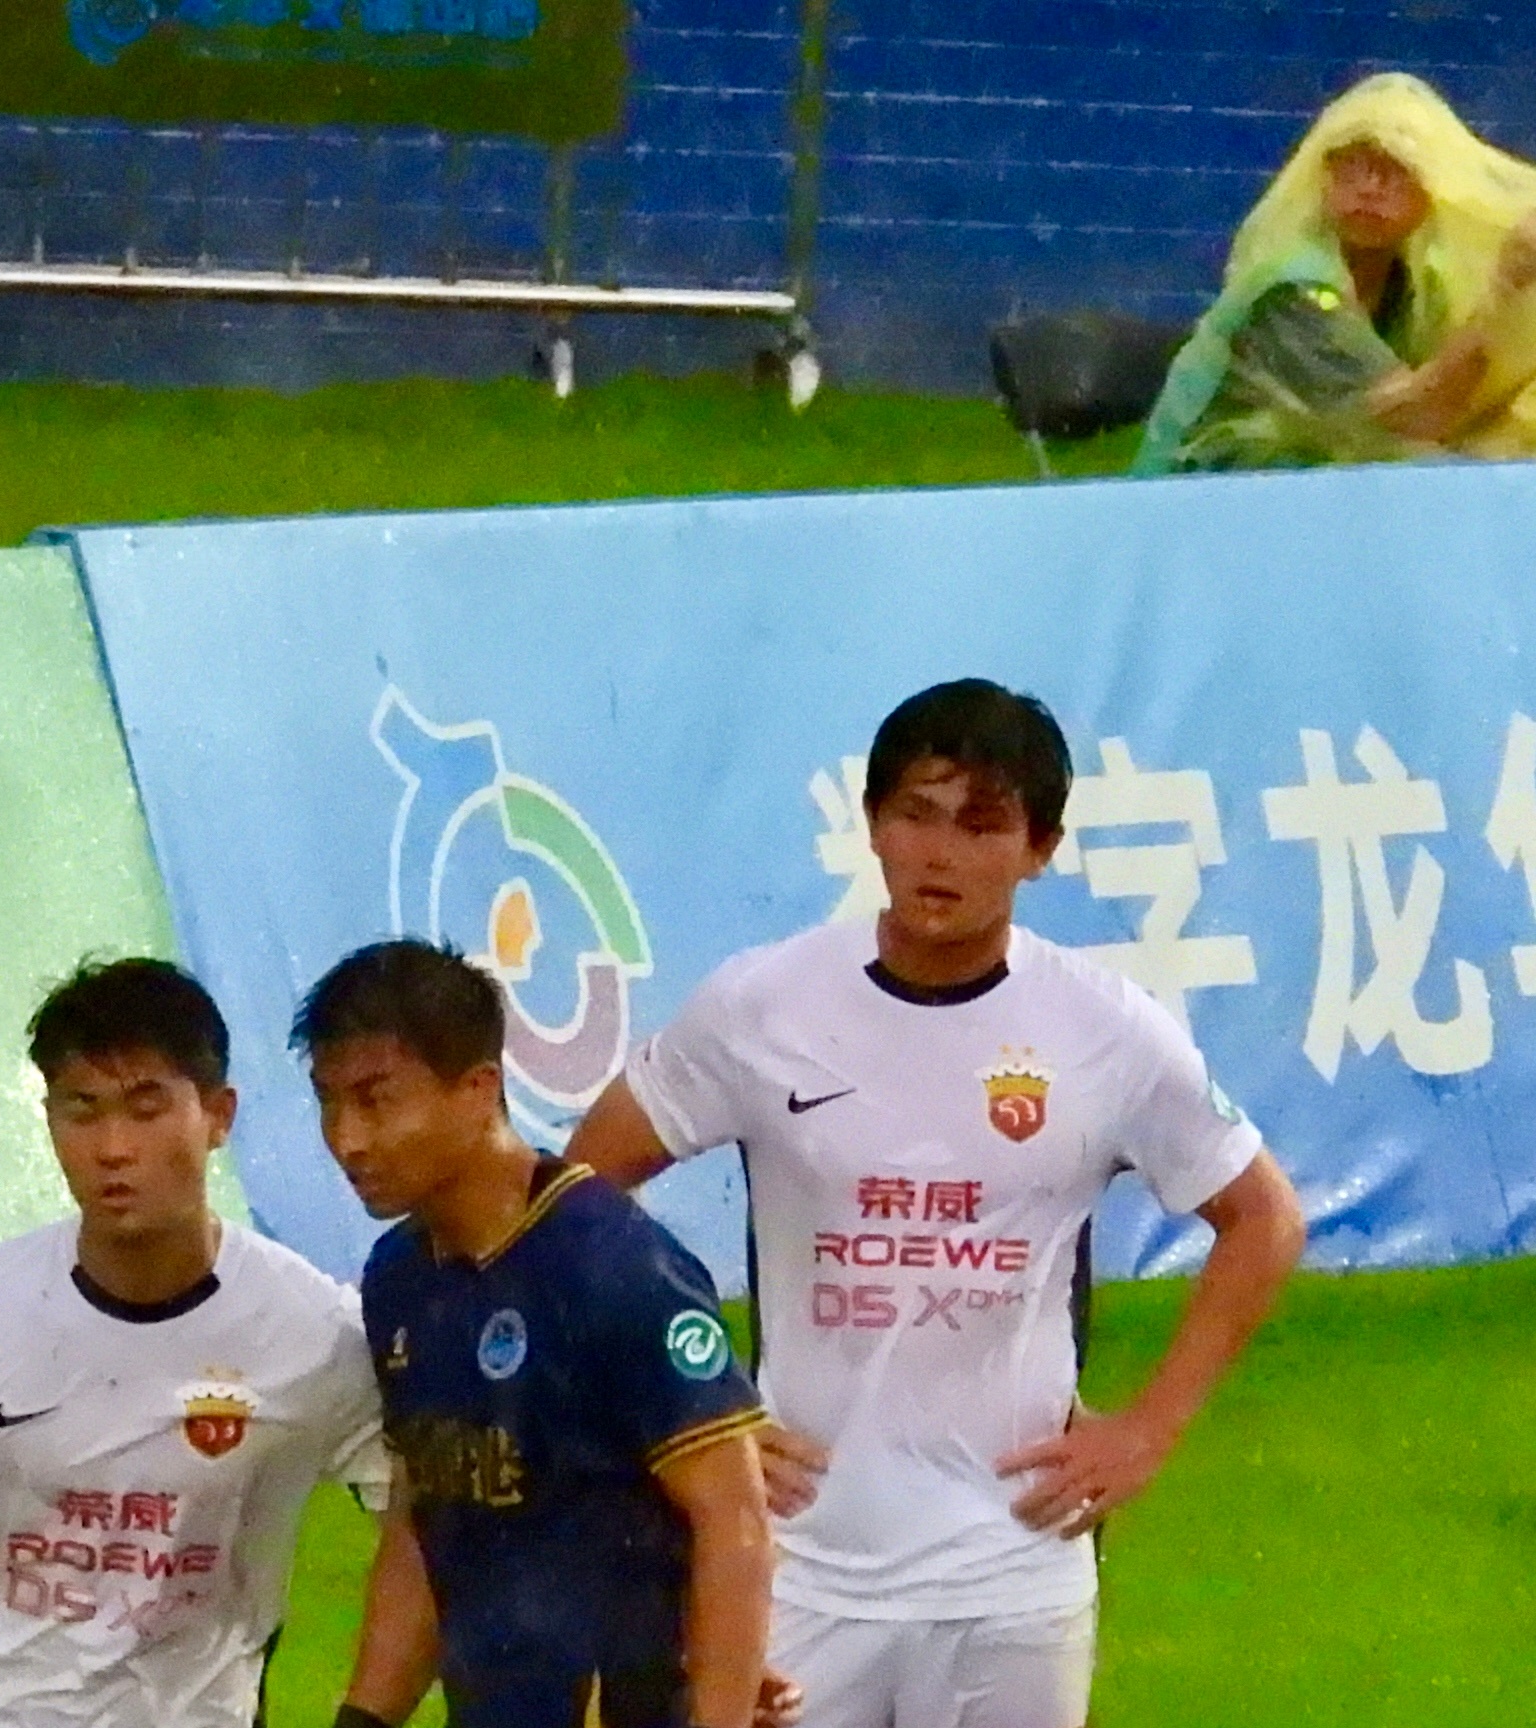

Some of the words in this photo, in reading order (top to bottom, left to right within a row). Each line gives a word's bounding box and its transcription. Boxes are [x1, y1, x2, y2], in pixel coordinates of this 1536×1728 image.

[856, 1175, 983, 1224] 荣威
[814, 1232, 1030, 1273] ROEWE
[57, 1489, 179, 1538] 荣威
[7, 1532, 221, 1581] ROEWE
